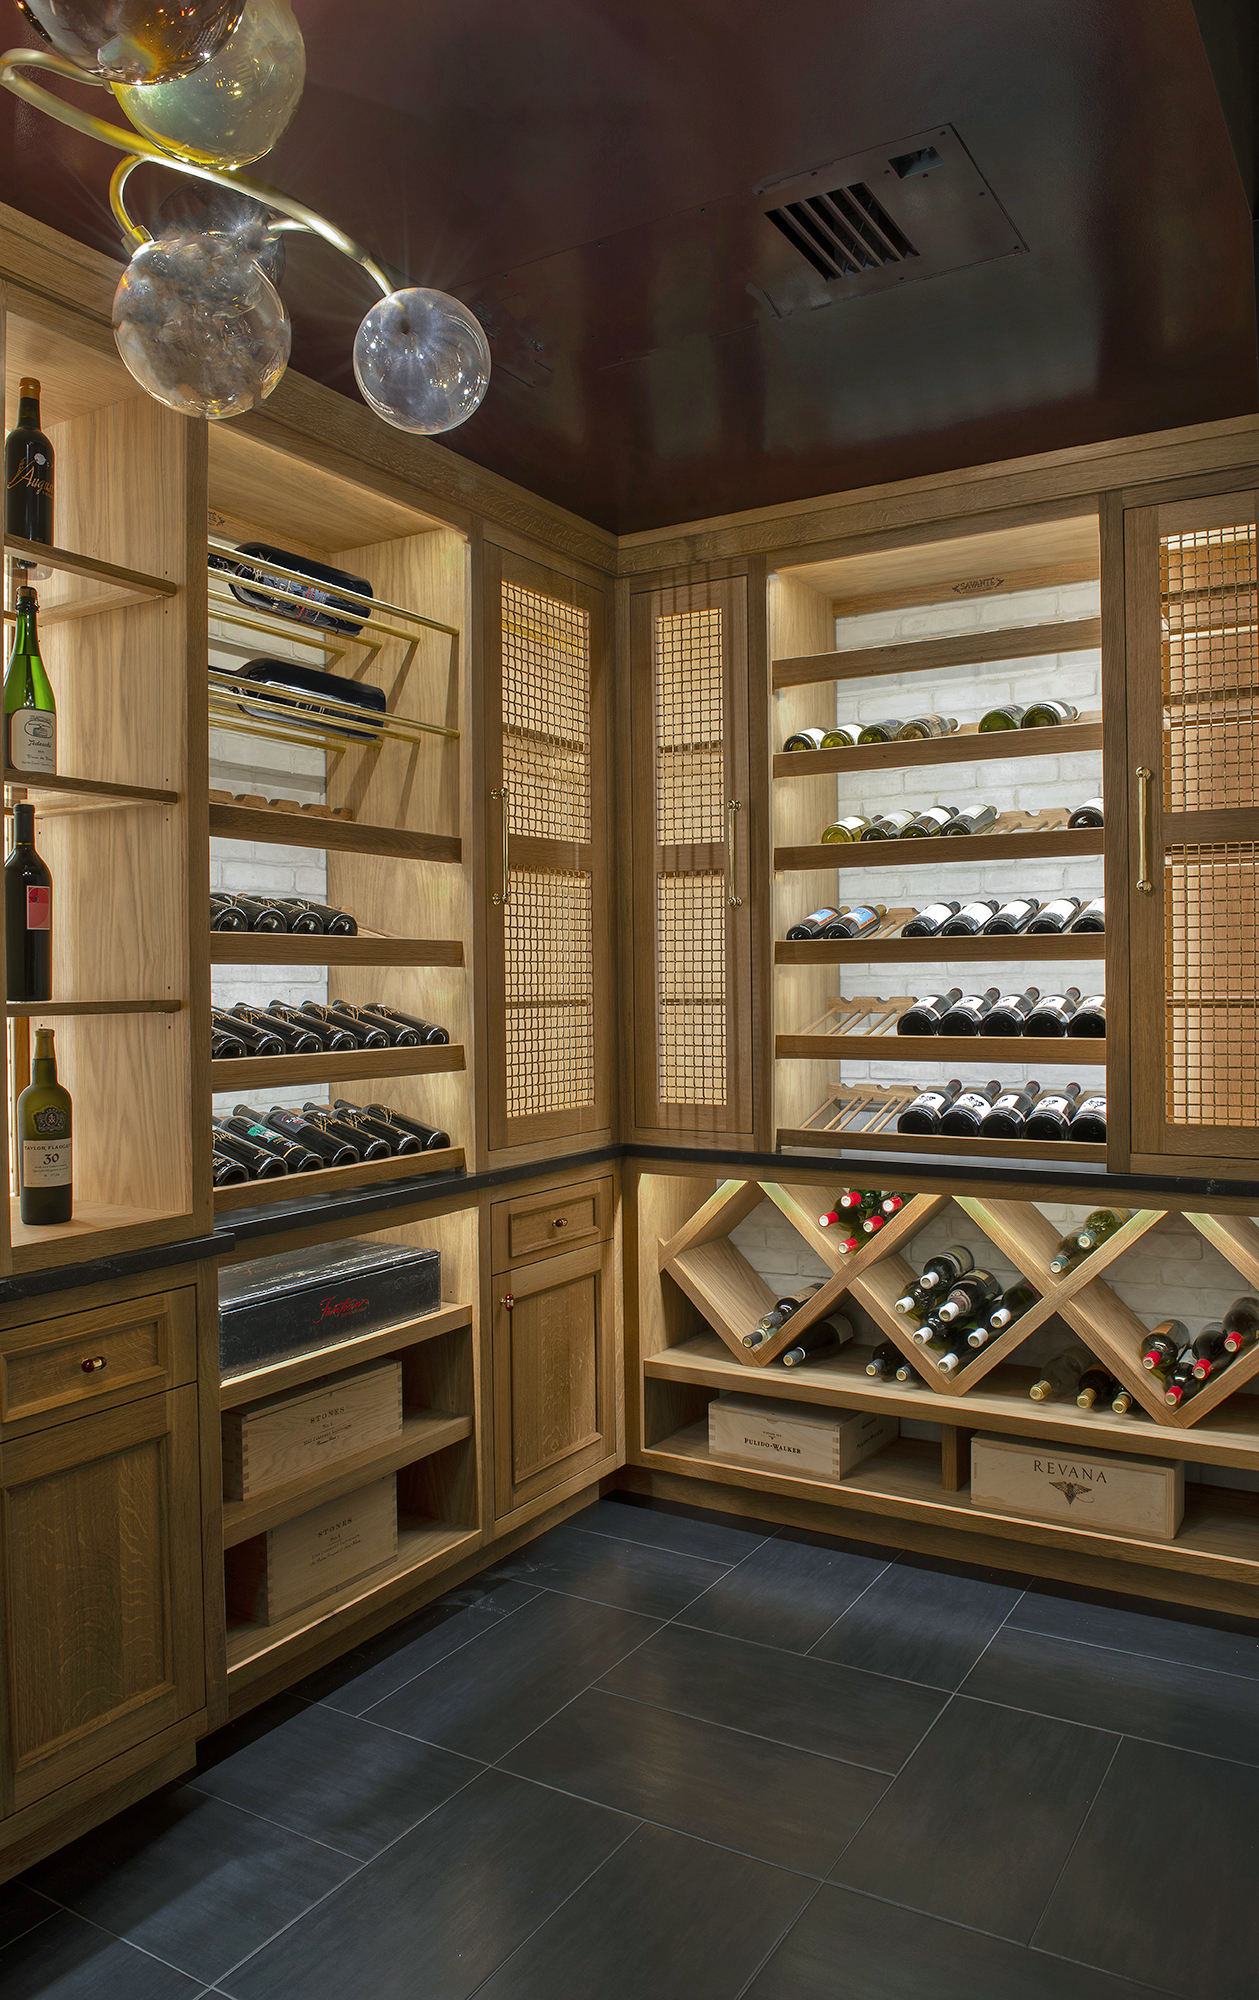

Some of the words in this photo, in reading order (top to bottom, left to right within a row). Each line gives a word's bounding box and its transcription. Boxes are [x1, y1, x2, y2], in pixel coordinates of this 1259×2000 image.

[43, 1152, 60, 1165] 30
[310, 1406, 345, 1424] STONES
[1033, 1459, 1107, 1484] REVANA
[317, 1517, 352, 1538] STONES
